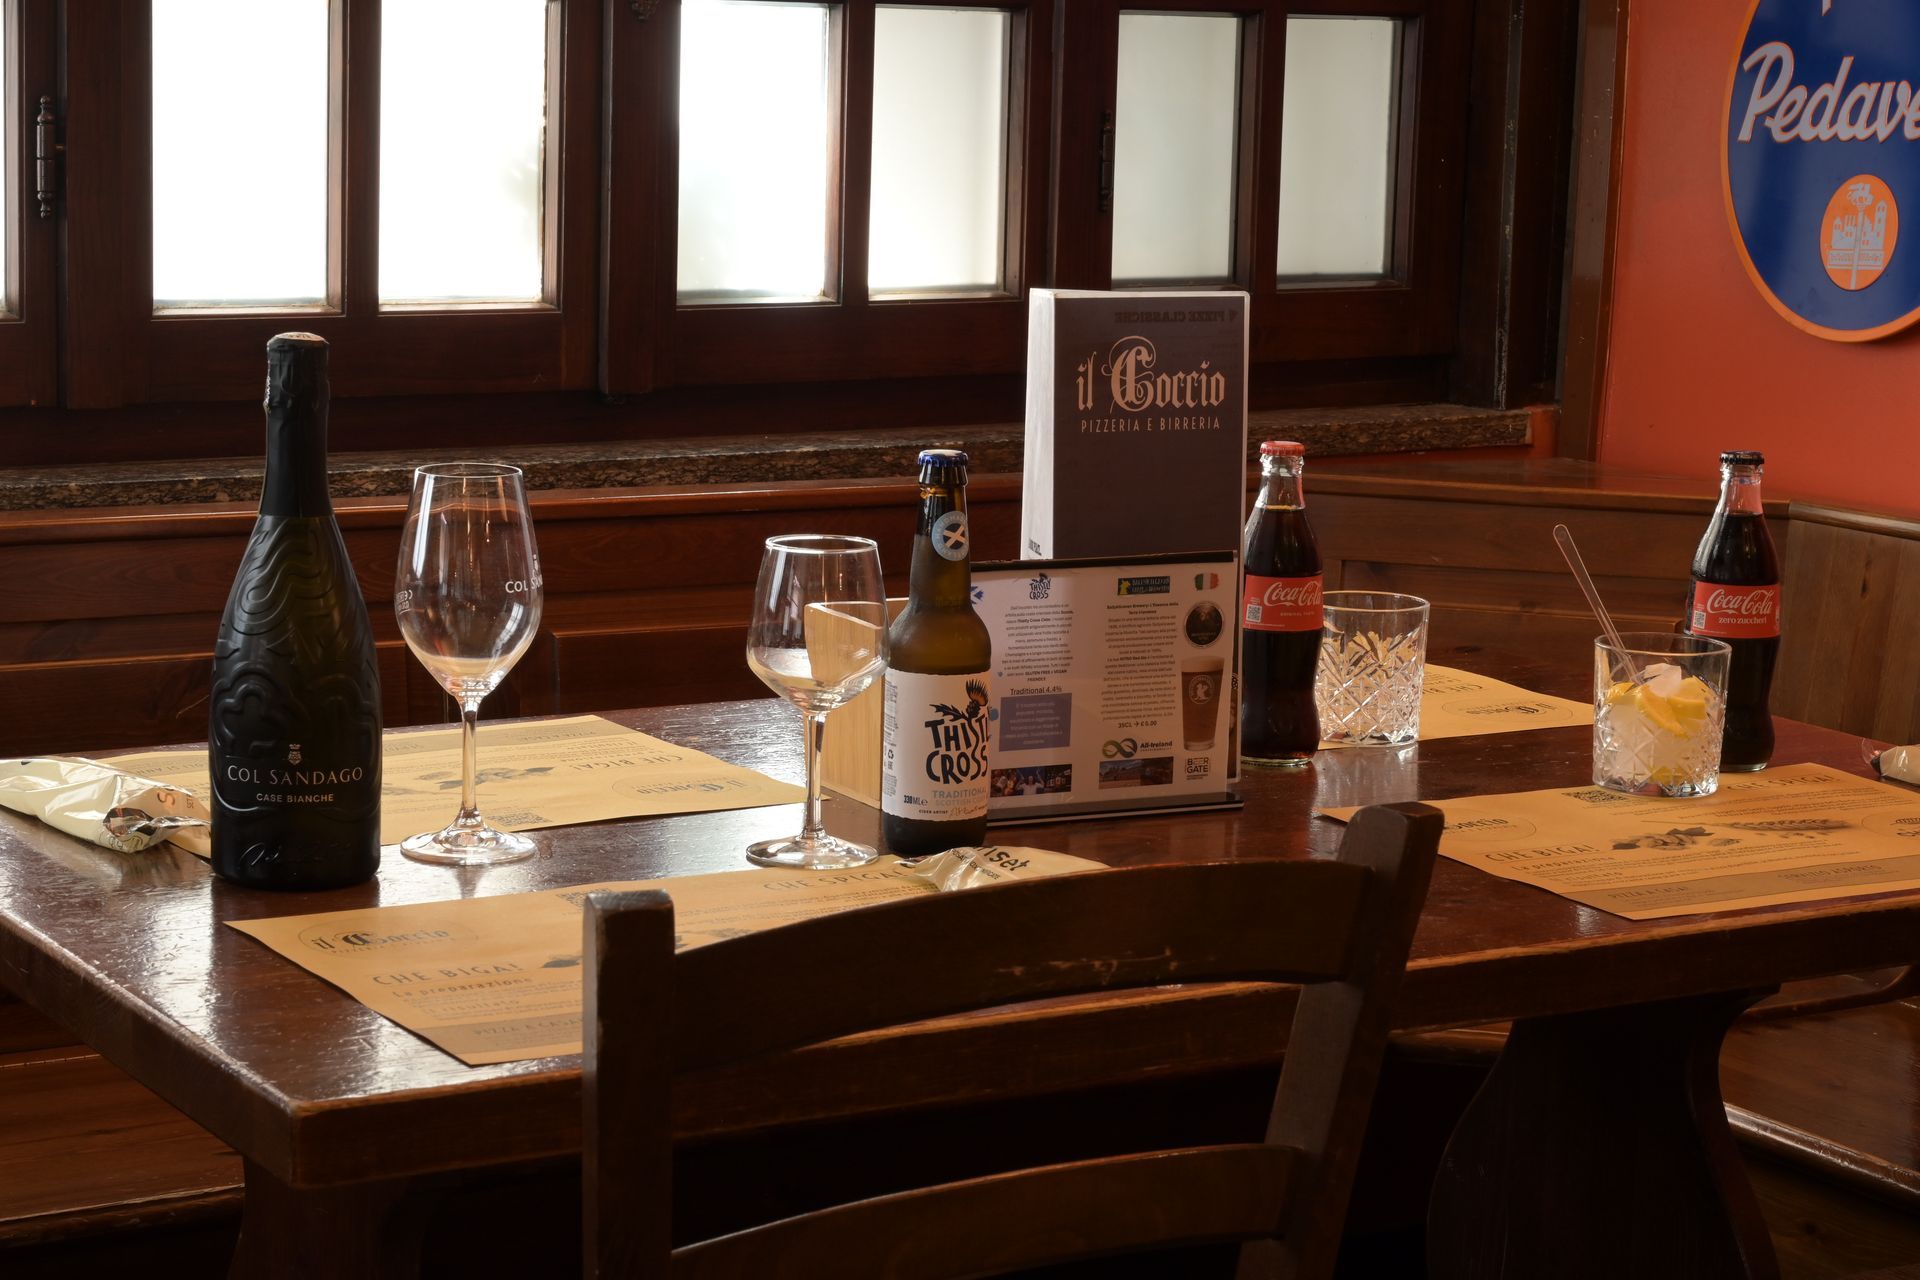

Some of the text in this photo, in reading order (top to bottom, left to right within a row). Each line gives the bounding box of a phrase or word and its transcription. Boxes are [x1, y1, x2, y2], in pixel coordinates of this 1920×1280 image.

[1076, 335, 1226, 414] il Coccio
[1081, 416, 1220, 433] PIZZERIA E BIRRERIA
[505, 579, 529, 594] COL
[1029, 590, 1049, 601] CROSS
[1706, 588, 1776, 616] Coca-Cola
[1718, 617, 1736, 625] zero
[1010, 687, 1045, 696] Traditional
[924, 713, 990, 752] THISTL
[925, 744, 989, 787] CROSS
[1187, 757, 1209, 766] BEER
[1187, 765, 1209, 774] GATE
[227, 765, 261, 784] COL
[270, 767, 363, 785] SANDAGO
[256, 793, 334, 803] CASE BIANCHE
[1485, 844, 1600, 863] CHE BIGA!
[763, 880, 812, 891] CHE
[372, 963, 524, 986] CHE BIGA!
[419, 978, 533, 996] preparazione
